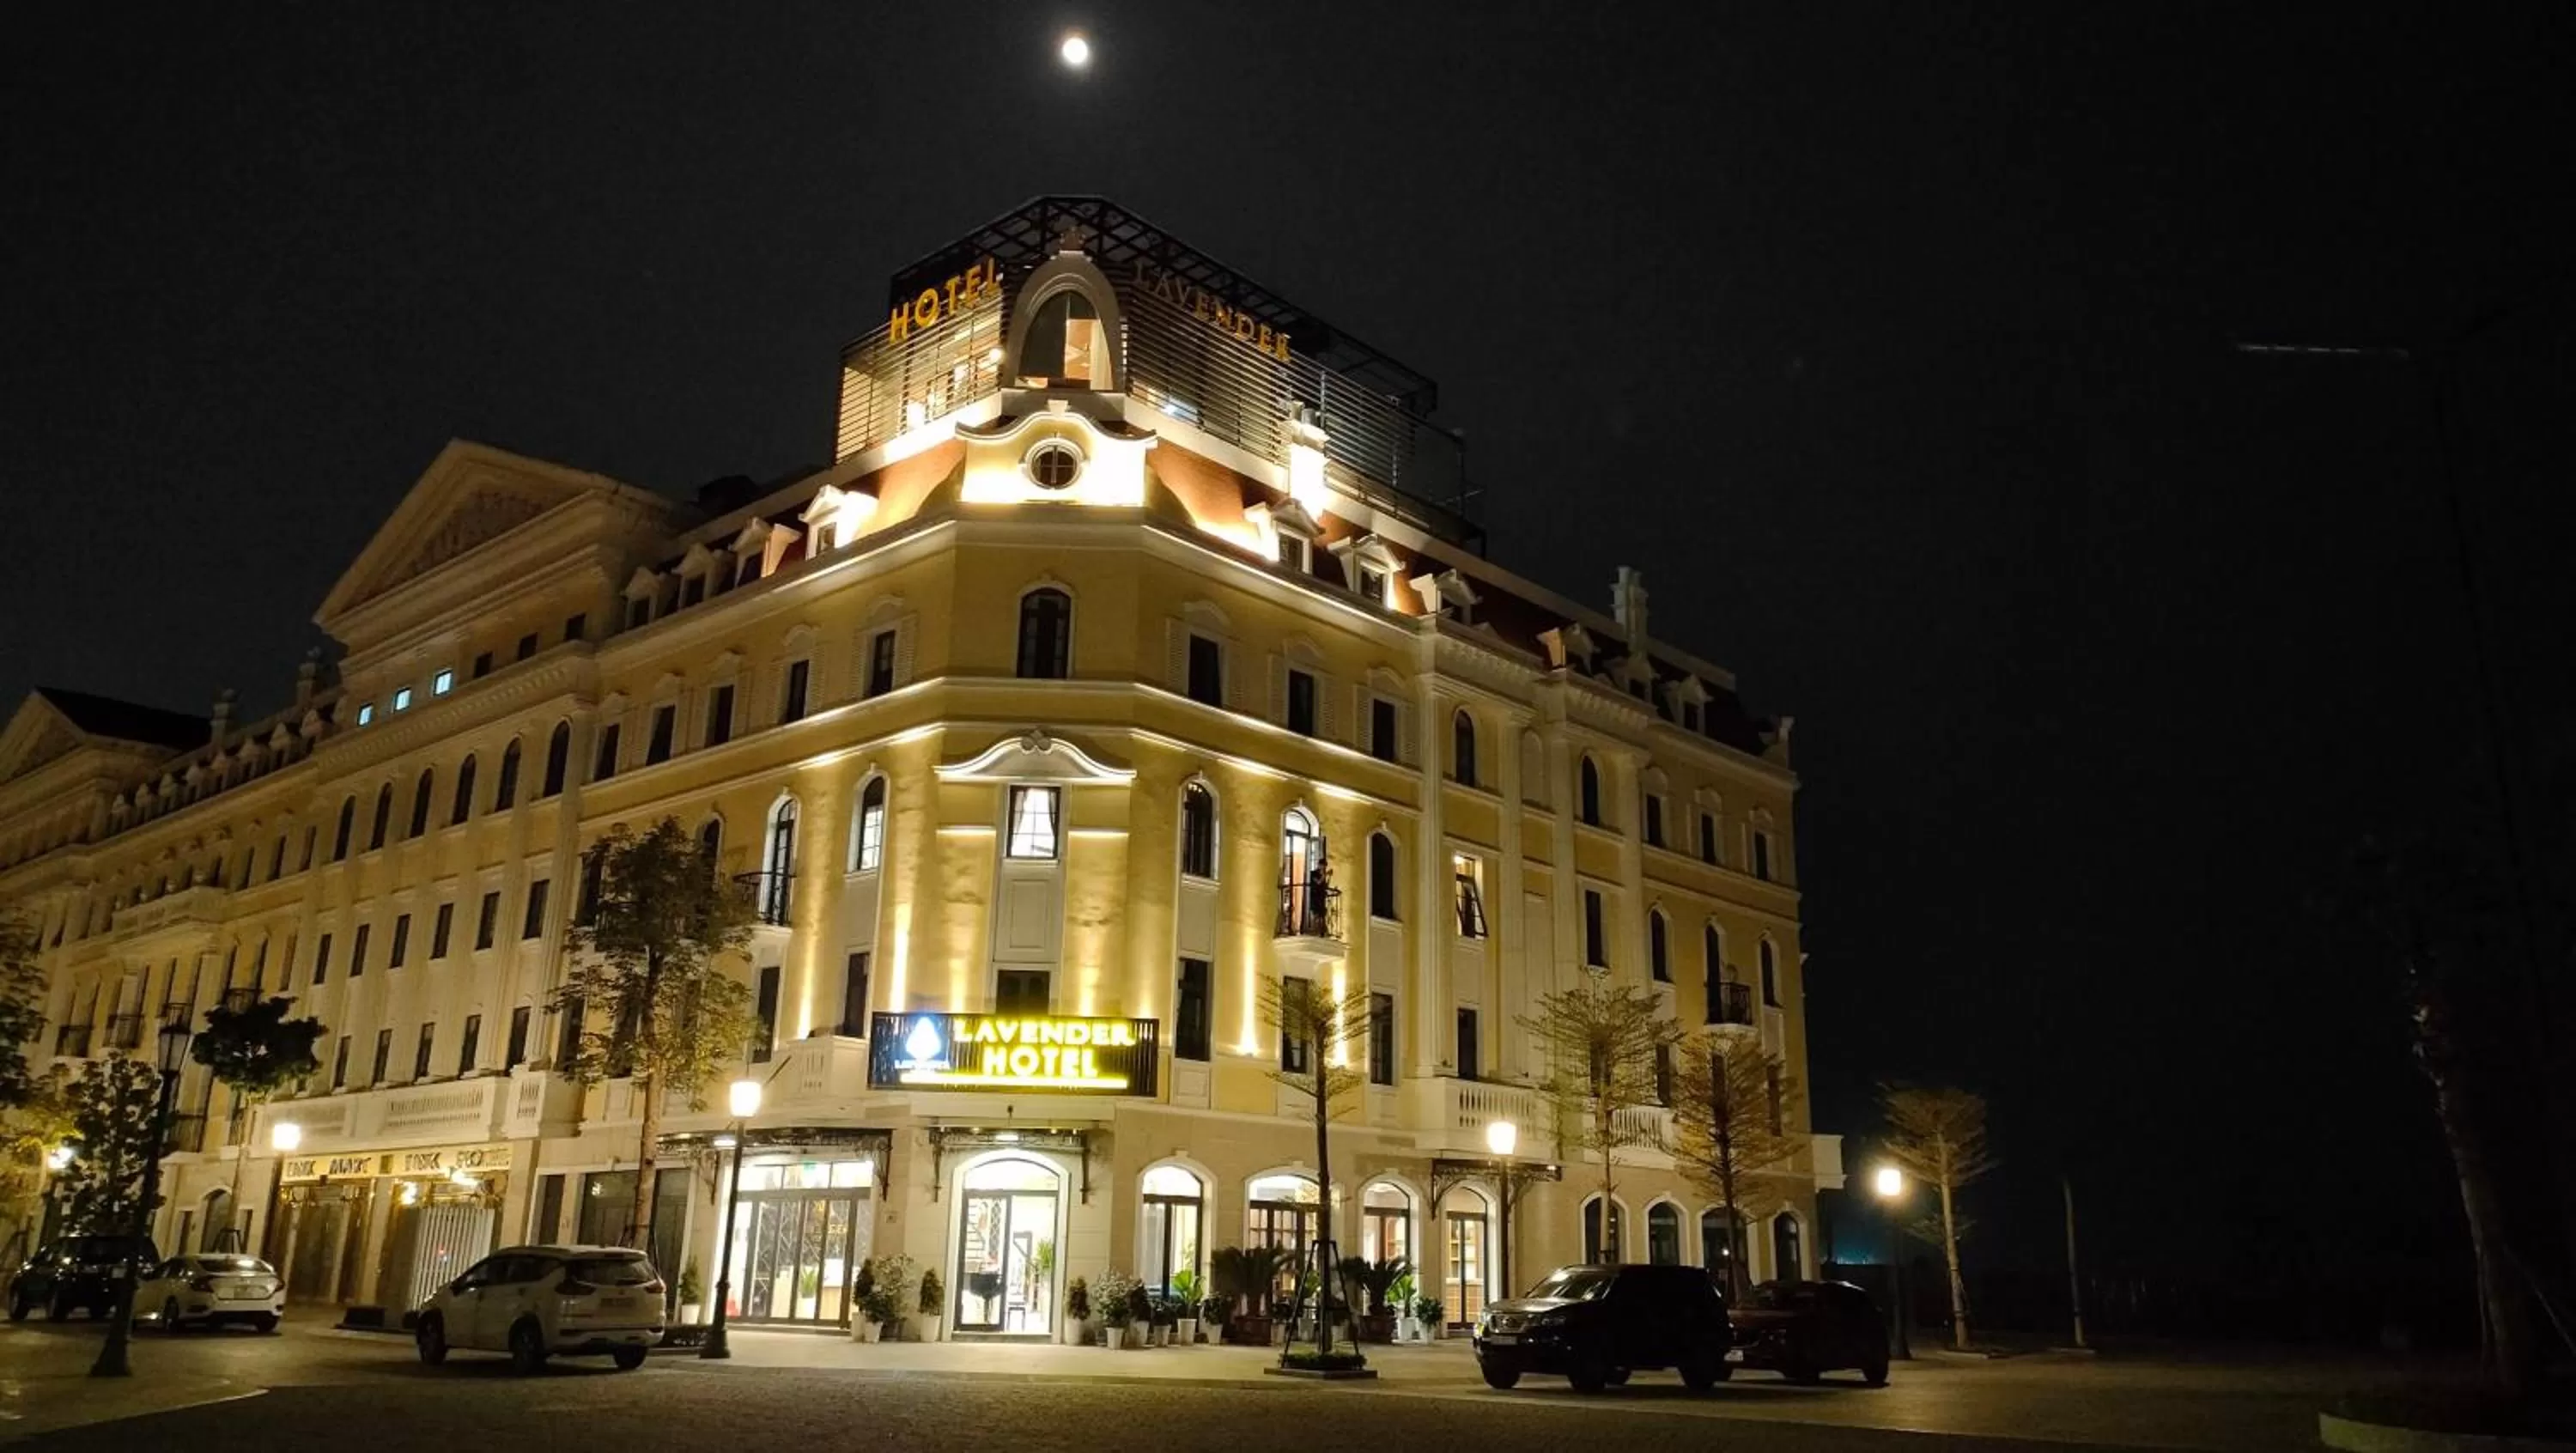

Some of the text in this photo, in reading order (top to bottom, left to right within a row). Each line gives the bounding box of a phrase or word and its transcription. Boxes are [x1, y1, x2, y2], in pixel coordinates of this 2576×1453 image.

[889, 257, 1004, 344] HOTEL
[1133, 257, 1291, 362] LAVENDER
[954, 1018, 1136, 1047] LAVENDER
[983, 1047, 1098, 1077] HOTEL
